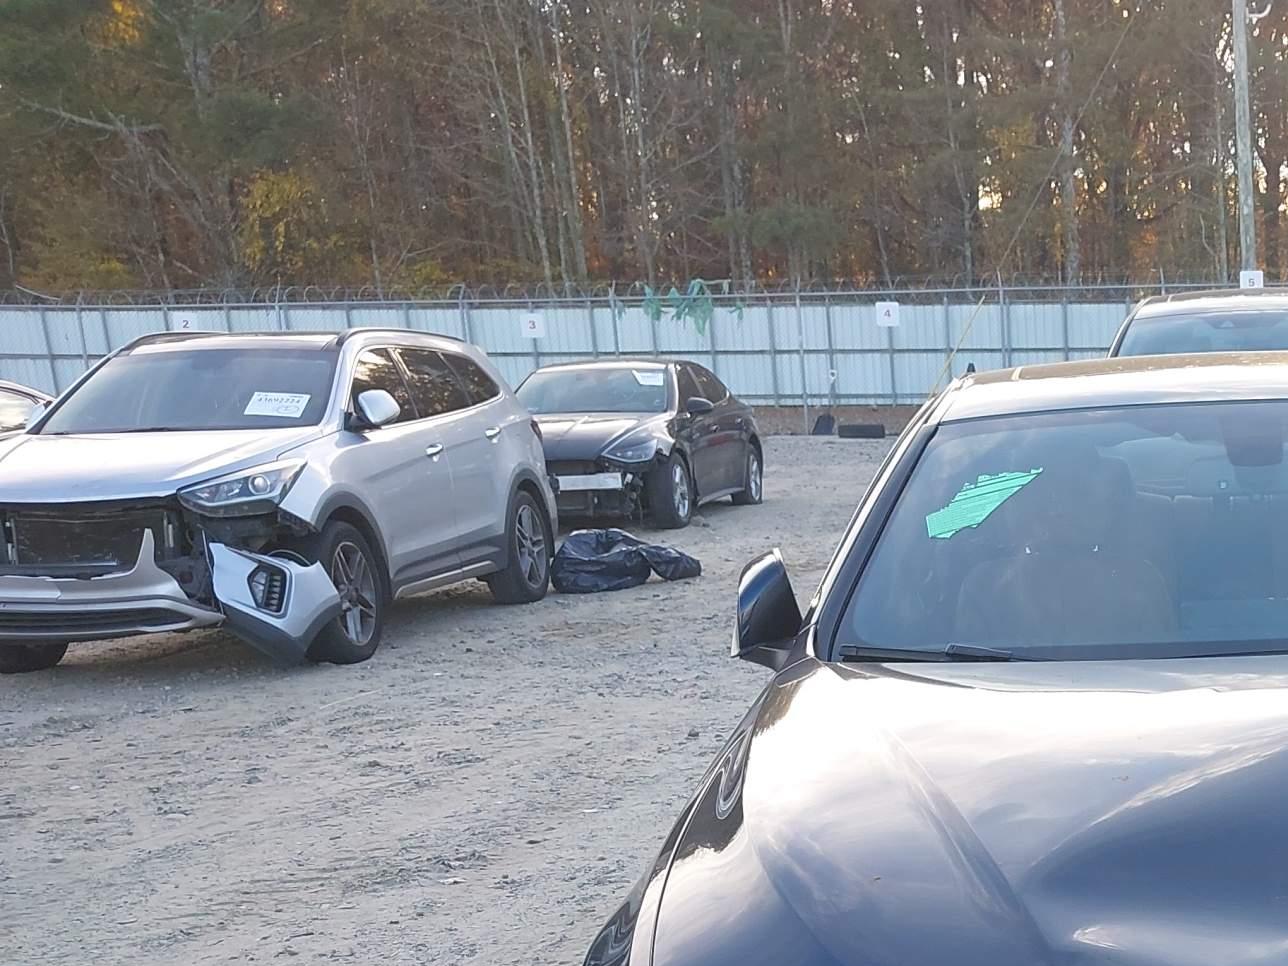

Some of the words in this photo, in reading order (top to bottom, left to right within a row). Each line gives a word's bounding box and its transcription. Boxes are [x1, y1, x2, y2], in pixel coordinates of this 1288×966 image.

[1248, 278, 1255, 287] 5
[884, 309, 891, 318] 4
[182, 319, 190, 329] 2
[528, 320, 537, 330] 3
